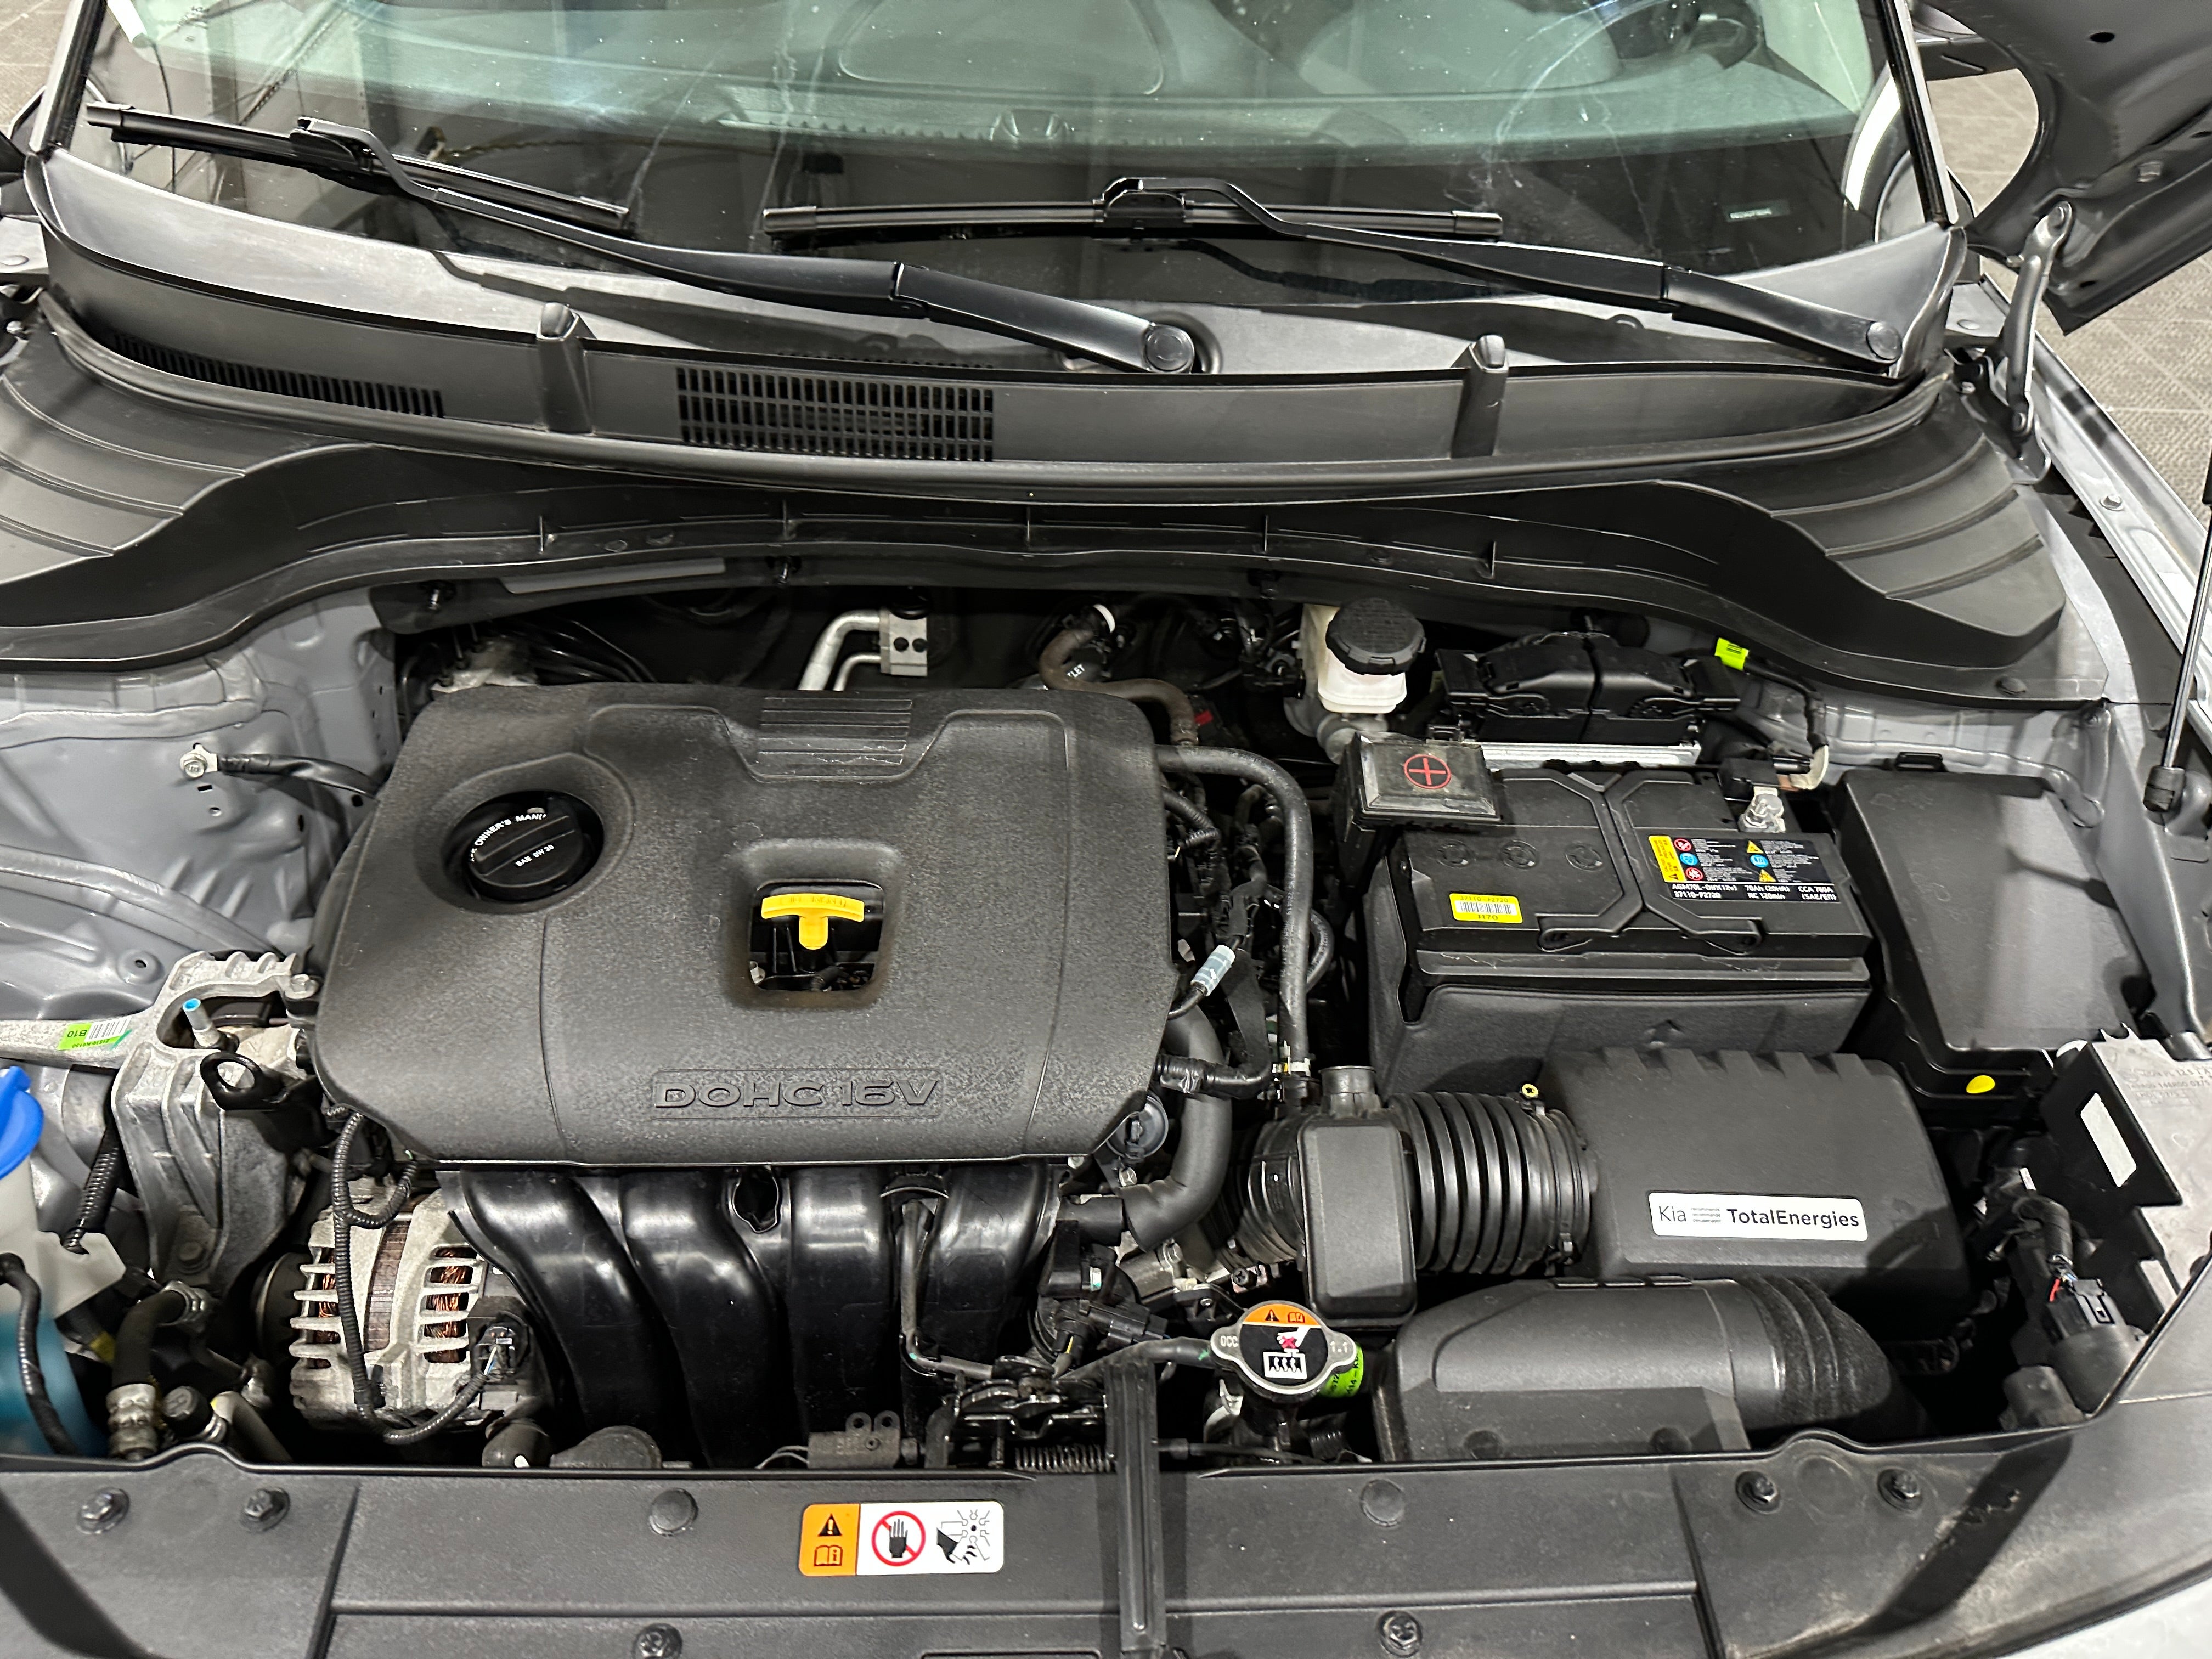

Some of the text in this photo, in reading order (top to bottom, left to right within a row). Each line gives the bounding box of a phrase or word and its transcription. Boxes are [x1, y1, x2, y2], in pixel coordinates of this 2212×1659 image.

[475, 819, 512, 846] OWNER'S
[516, 856, 533, 866] SAE
[67, 1030, 88, 1038] B10
[655, 1080, 938, 1107] DOHC 16V
[1658, 1205, 1859, 1229] Kia TotalEnergies
[1221, 1335, 1238, 1347] DCC
[1330, 1341, 1348, 1353] 1.1
